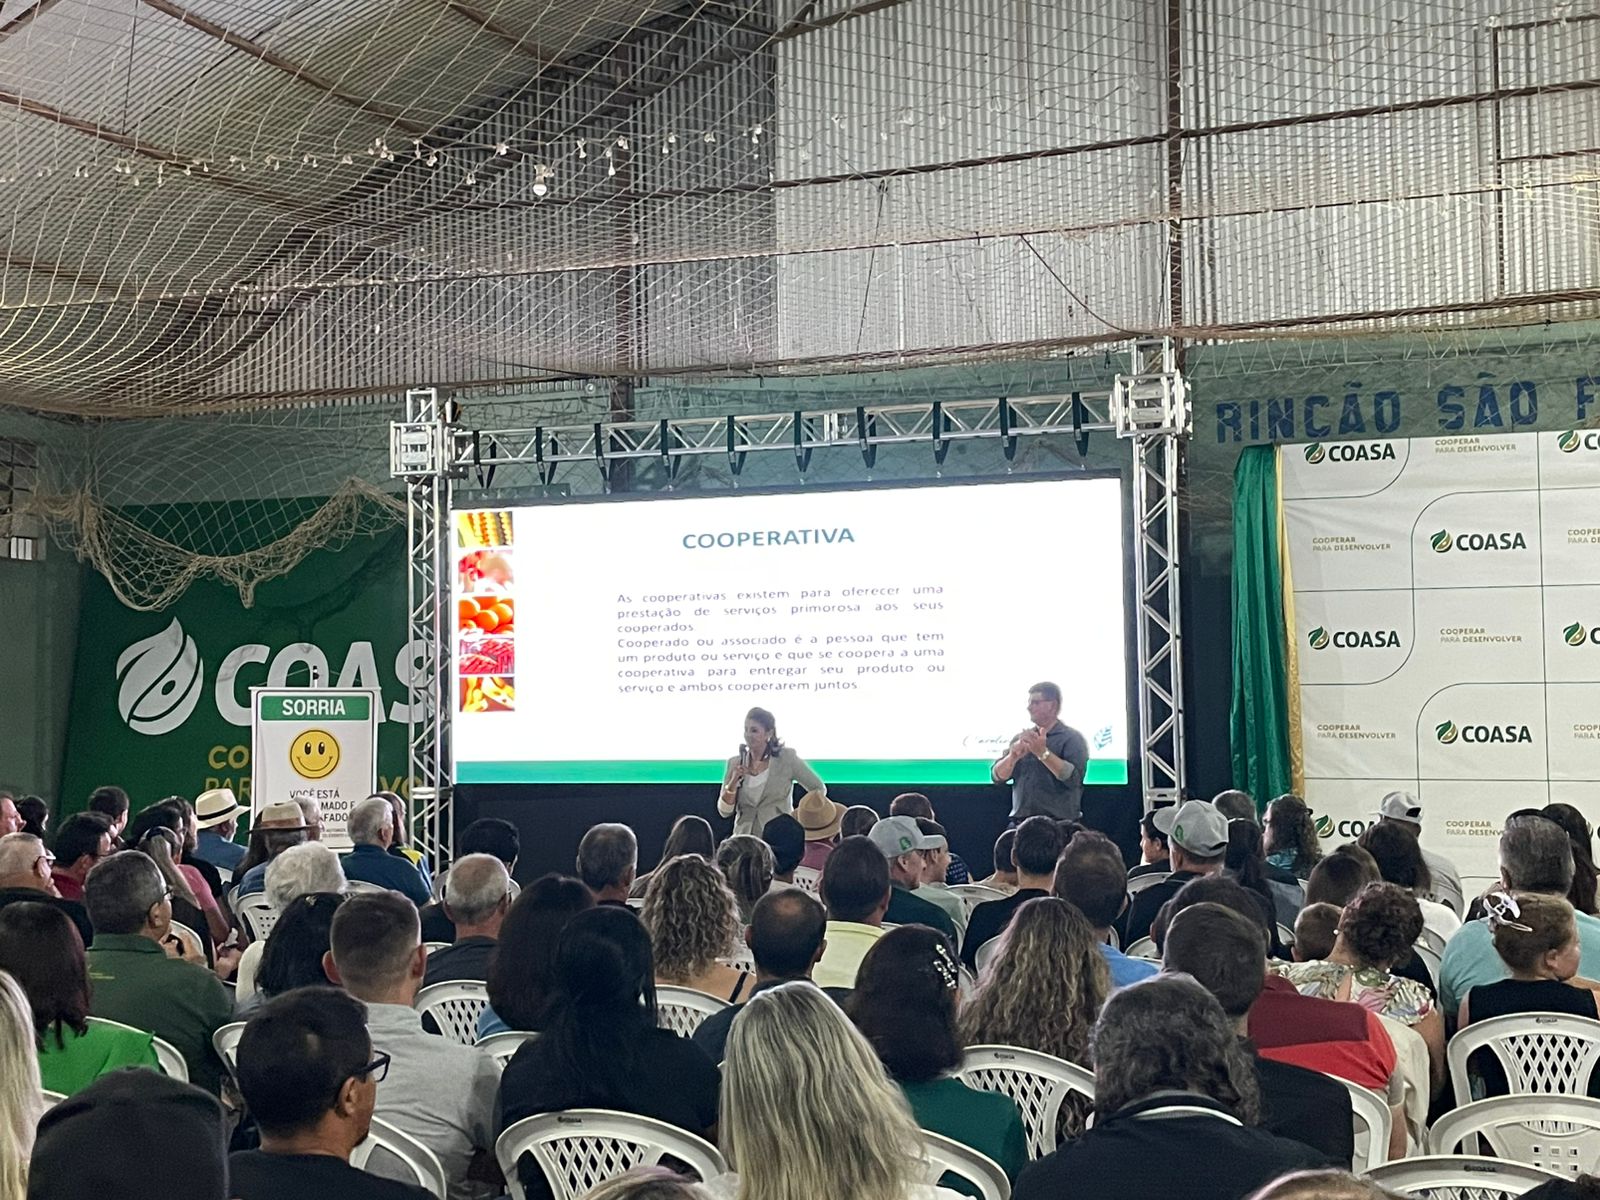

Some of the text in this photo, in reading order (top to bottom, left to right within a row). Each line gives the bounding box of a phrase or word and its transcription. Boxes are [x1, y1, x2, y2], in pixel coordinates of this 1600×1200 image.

[1216, 381, 1400, 443] RINCÃO
[1437, 371, 1538, 430] SÃO
[1434, 437, 1480, 446] COOPERAR
[1435, 444, 1516, 454] PARA DESENVOLVER
[1328, 443, 1396, 463] COASA
[683, 528, 855, 549] COOPERATIVA
[1312, 536, 1356, 544] COOPERAR
[1334, 543, 1391, 551] DESENVOLVER
[1456, 533, 1527, 552] COASA
[617, 585, 944, 604] As cooperativas existem para oferecer uma
[617, 601, 944, 620] prestação de serviços primorosa aos seus
[617, 632, 945, 649] Cooperado ou associado é a pessoa que tem
[1333, 630, 1401, 648] COASA
[1462, 635, 1522, 643] DESENVOLVER
[617, 648, 945, 664] um produto ou serviço e que se coopera a uma
[617, 663, 945, 679] cooperativa para entregar seu produto ou
[618, 684, 664, 695] serviço
[667, 684, 676, 693] e
[679, 681, 724, 693] ambos
[727, 682, 810, 693] cooperarem
[282, 699, 346, 716] SORRIA
[1462, 726, 1532, 744] COASA
[317, 788, 340, 799] ESTÁ
